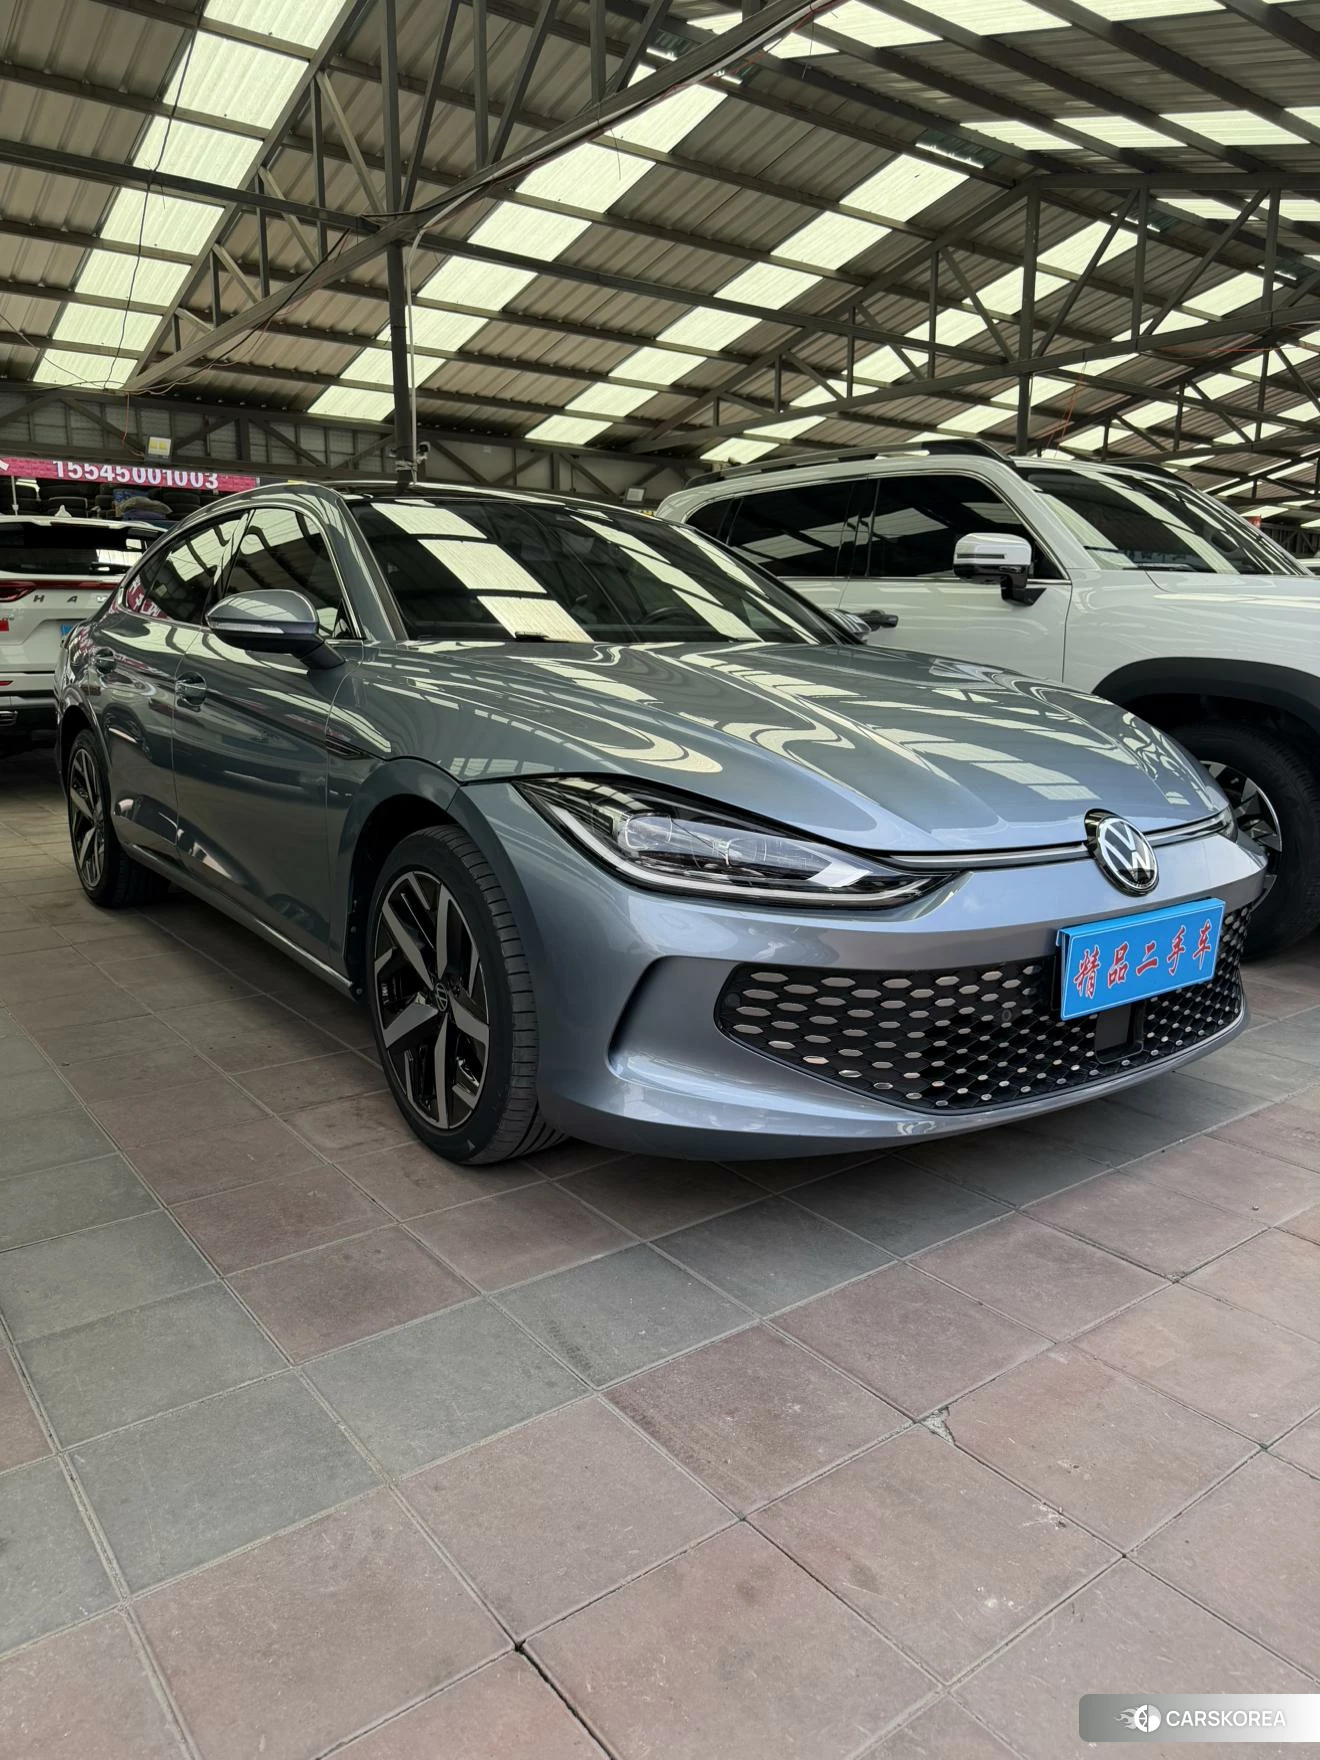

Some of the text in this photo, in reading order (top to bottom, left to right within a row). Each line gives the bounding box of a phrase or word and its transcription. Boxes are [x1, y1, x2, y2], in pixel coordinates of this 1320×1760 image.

[53, 460, 219, 489] 15545001003
[1073, 918, 1213, 999] 精品二手车
